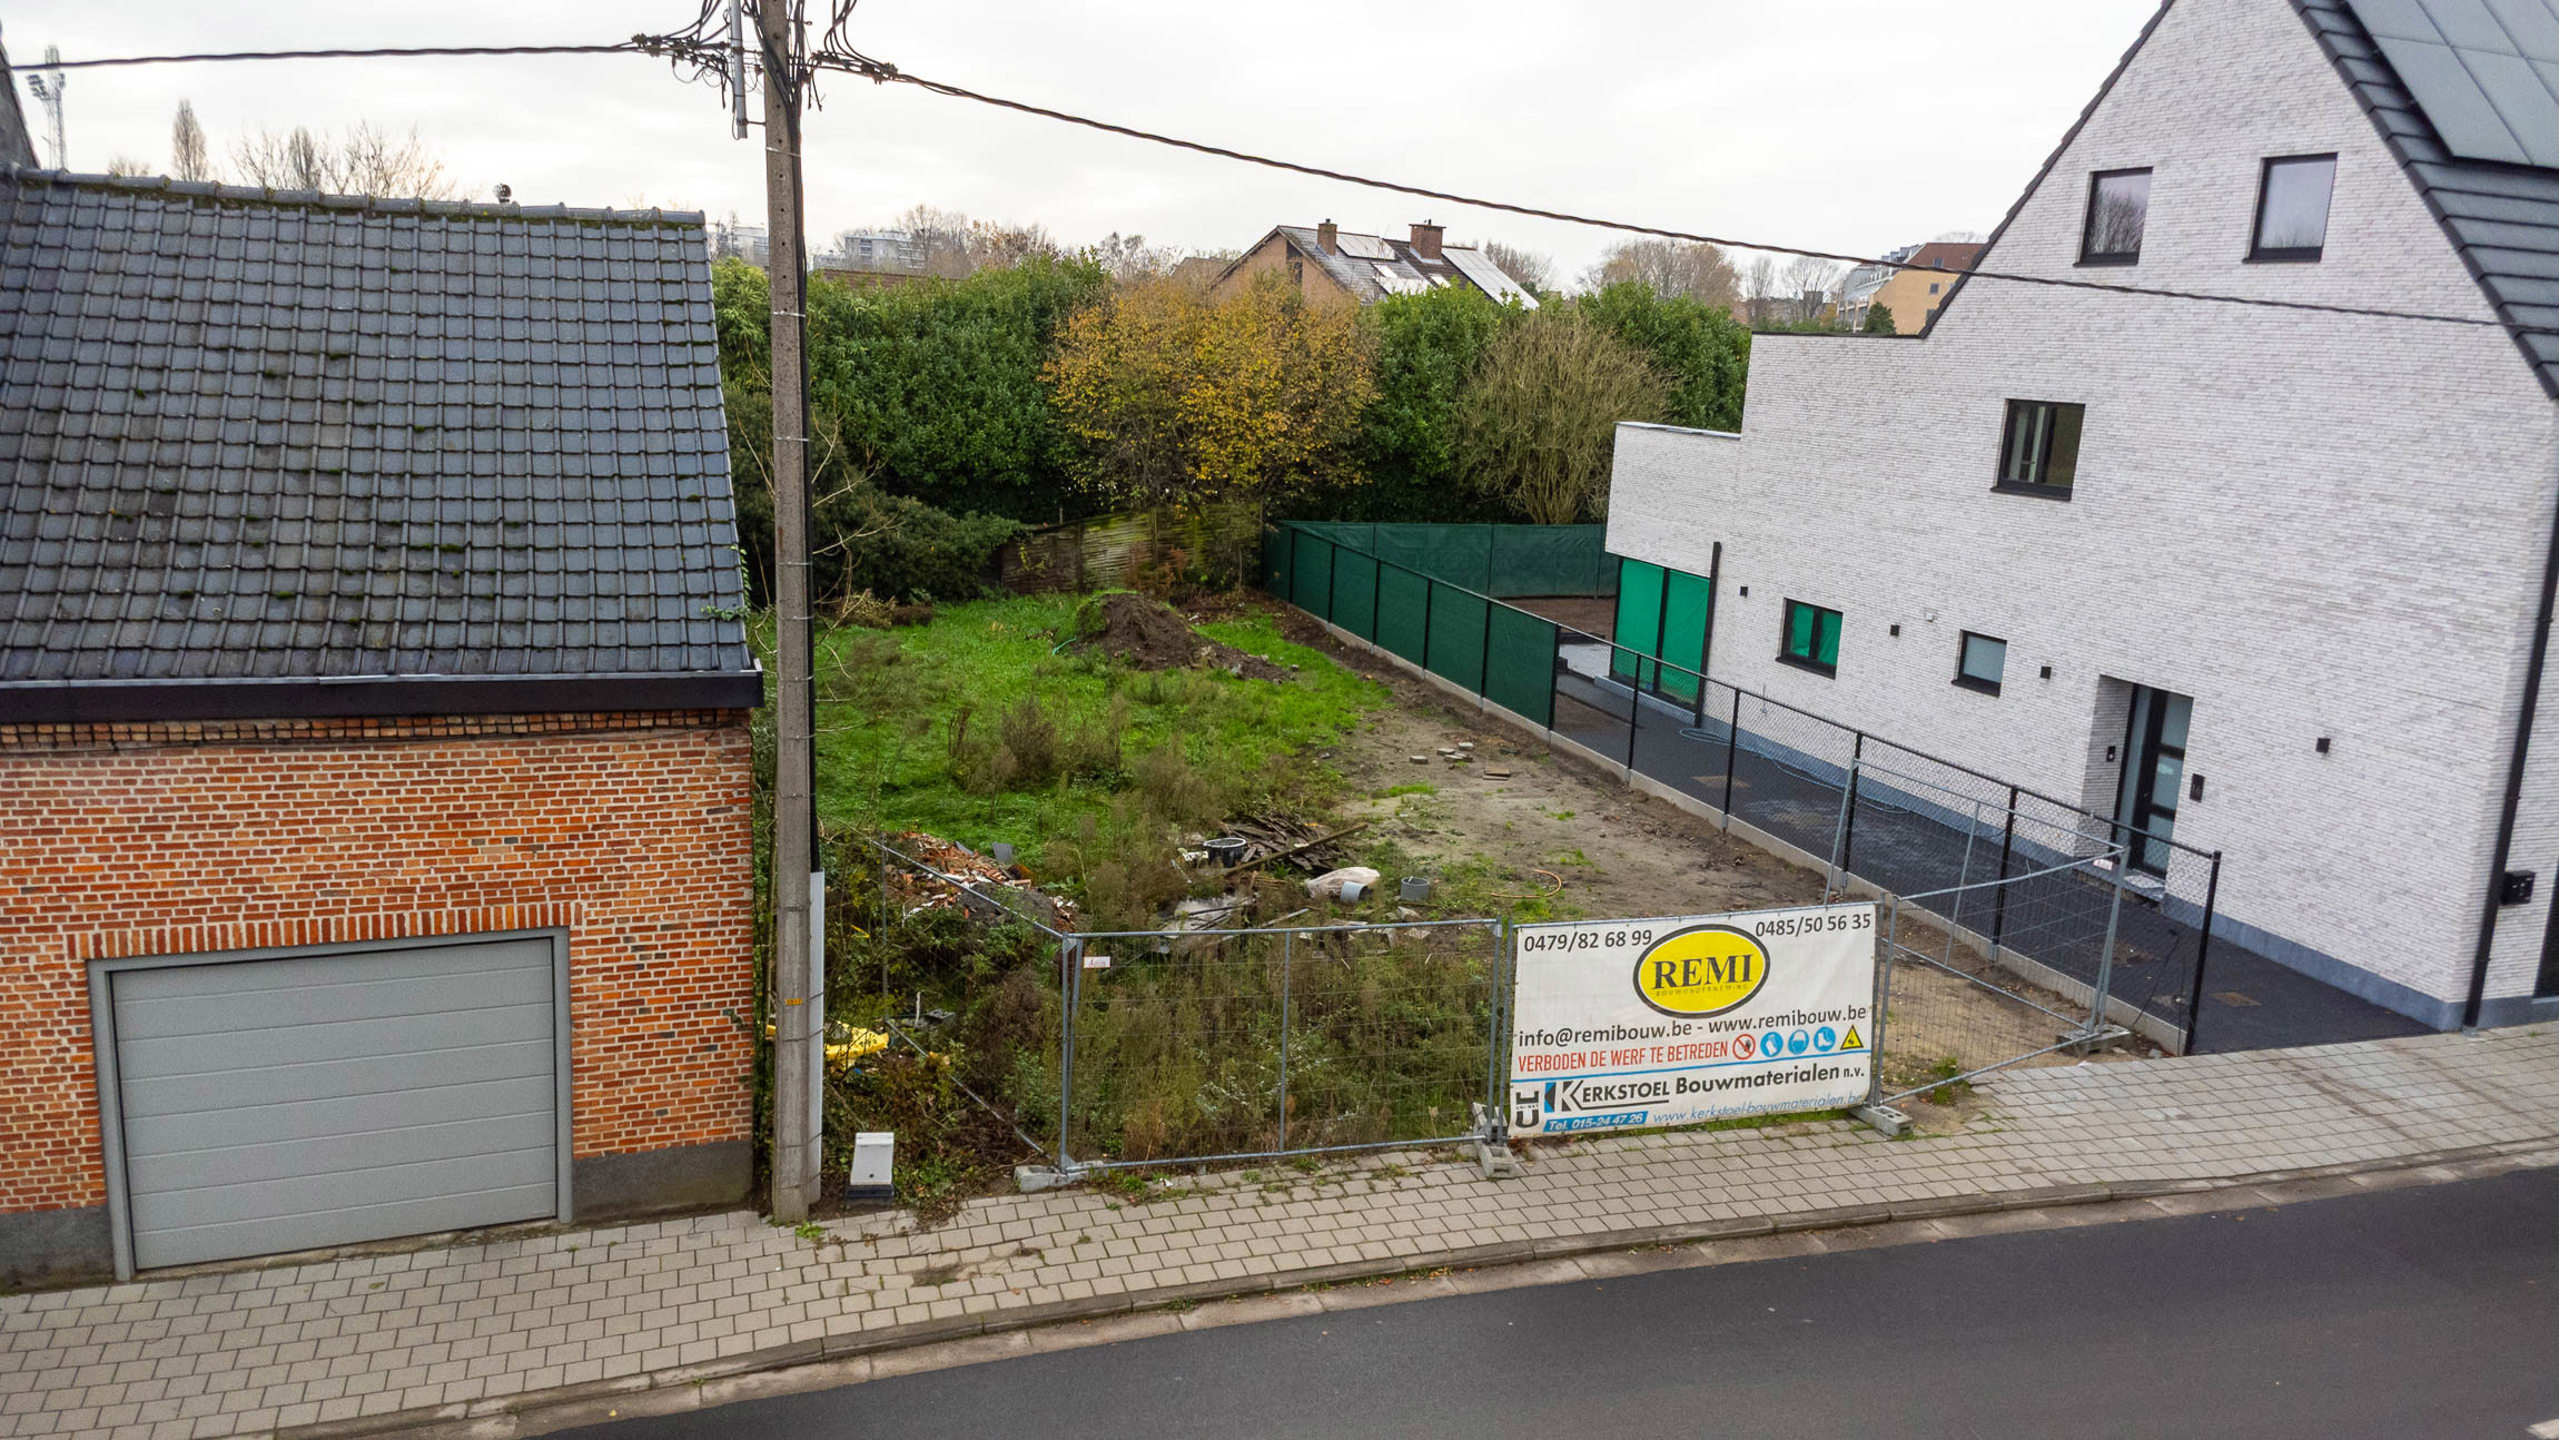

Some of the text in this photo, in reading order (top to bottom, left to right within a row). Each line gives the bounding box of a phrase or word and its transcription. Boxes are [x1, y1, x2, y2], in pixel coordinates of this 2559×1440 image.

[1524, 930, 1652, 952] 0479/82 68 99
[1756, 913, 1871, 937] 0485/50 56 35
[1652, 954, 1754, 990] REMI
[1518, 1020, 1692, 1047] info@remibouw.be
[1709, 1005, 1866, 1033] www.remibouw.be
[1518, 1041, 1728, 1073] VERBODEN DE WERF TE BETREDEN
[1676, 1063, 1839, 1095] Bouwmaterialen
[1843, 1066, 1865, 1078] n.v.
[1549, 1120, 1568, 1131] Tel.
[1571, 1116, 1611, 1129] 015-24
[1611, 1114, 1627, 1125] 47
